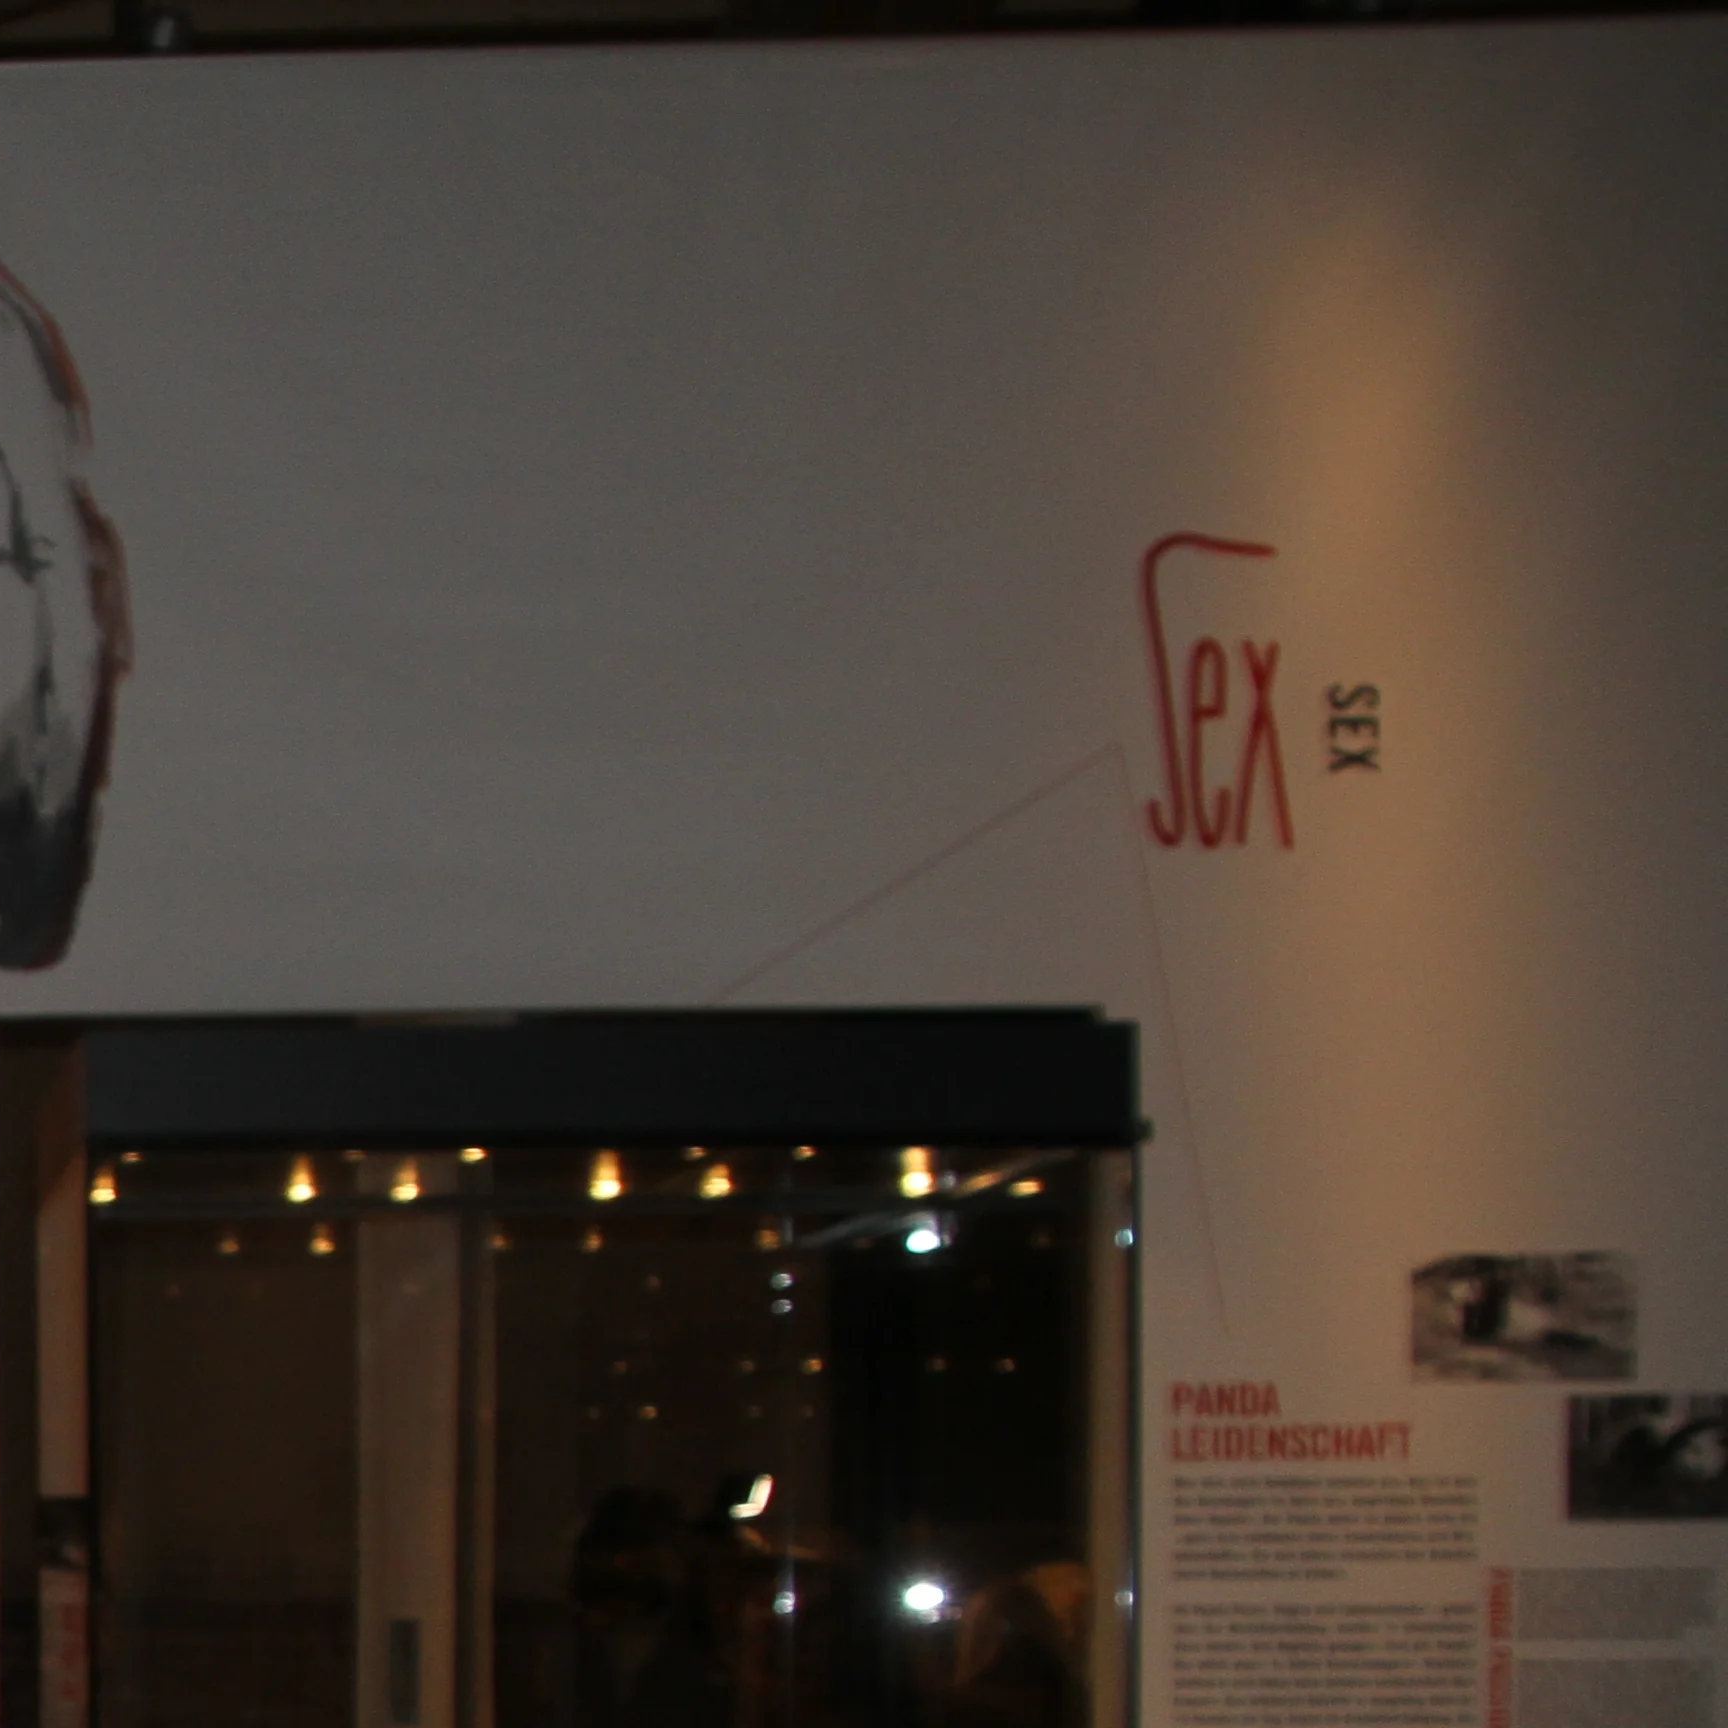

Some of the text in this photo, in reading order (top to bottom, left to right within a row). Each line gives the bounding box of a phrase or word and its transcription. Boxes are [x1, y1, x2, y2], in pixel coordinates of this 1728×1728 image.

[1138, 529, 1295, 851] Sex
[1325, 681, 1384, 774] SEX
[1169, 1380, 1282, 1419] PANDA
[1170, 1422, 1414, 1463] LEIDENSCHAFT
